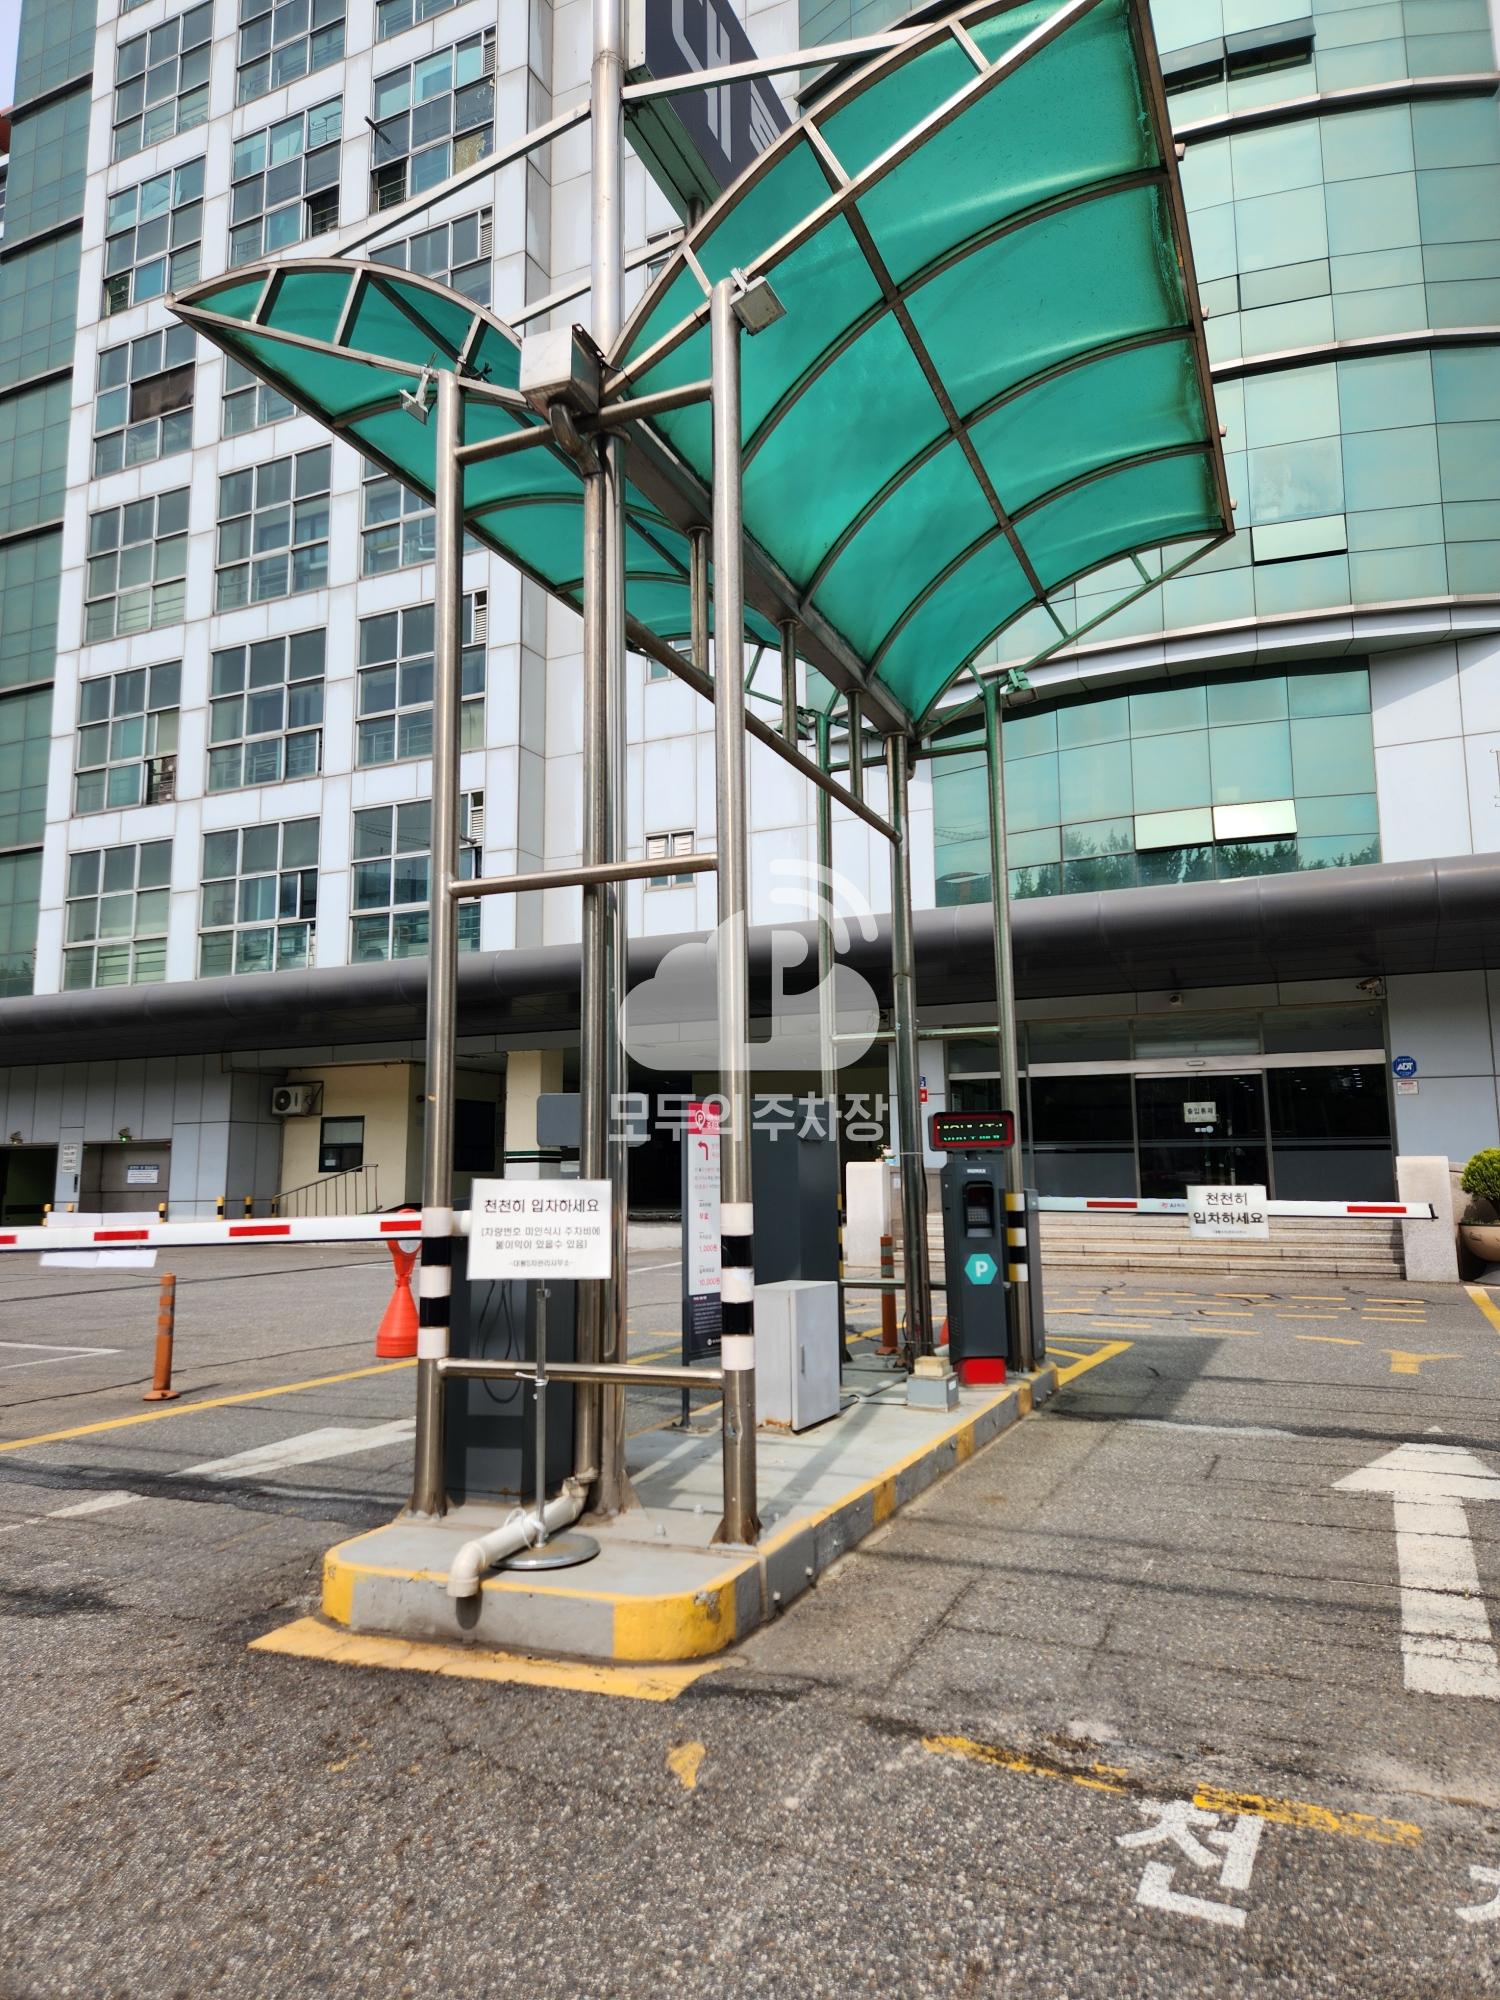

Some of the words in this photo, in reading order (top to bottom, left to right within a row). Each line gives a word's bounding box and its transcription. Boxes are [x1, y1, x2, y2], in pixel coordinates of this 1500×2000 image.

[1396, 1062, 1414, 1071] ADT
[1205, 1192, 1248, 1206] 천천히
[484, 1199, 525, 1213] 천천히
[531, 1199, 600, 1213] 입차하세요
[1193, 1212, 1264, 1225] 입차하세요
[525, 1226, 561, 1237] 미인식시
[564, 1226, 600, 1236] 주차비에
[975, 1260, 989, 1278] P
